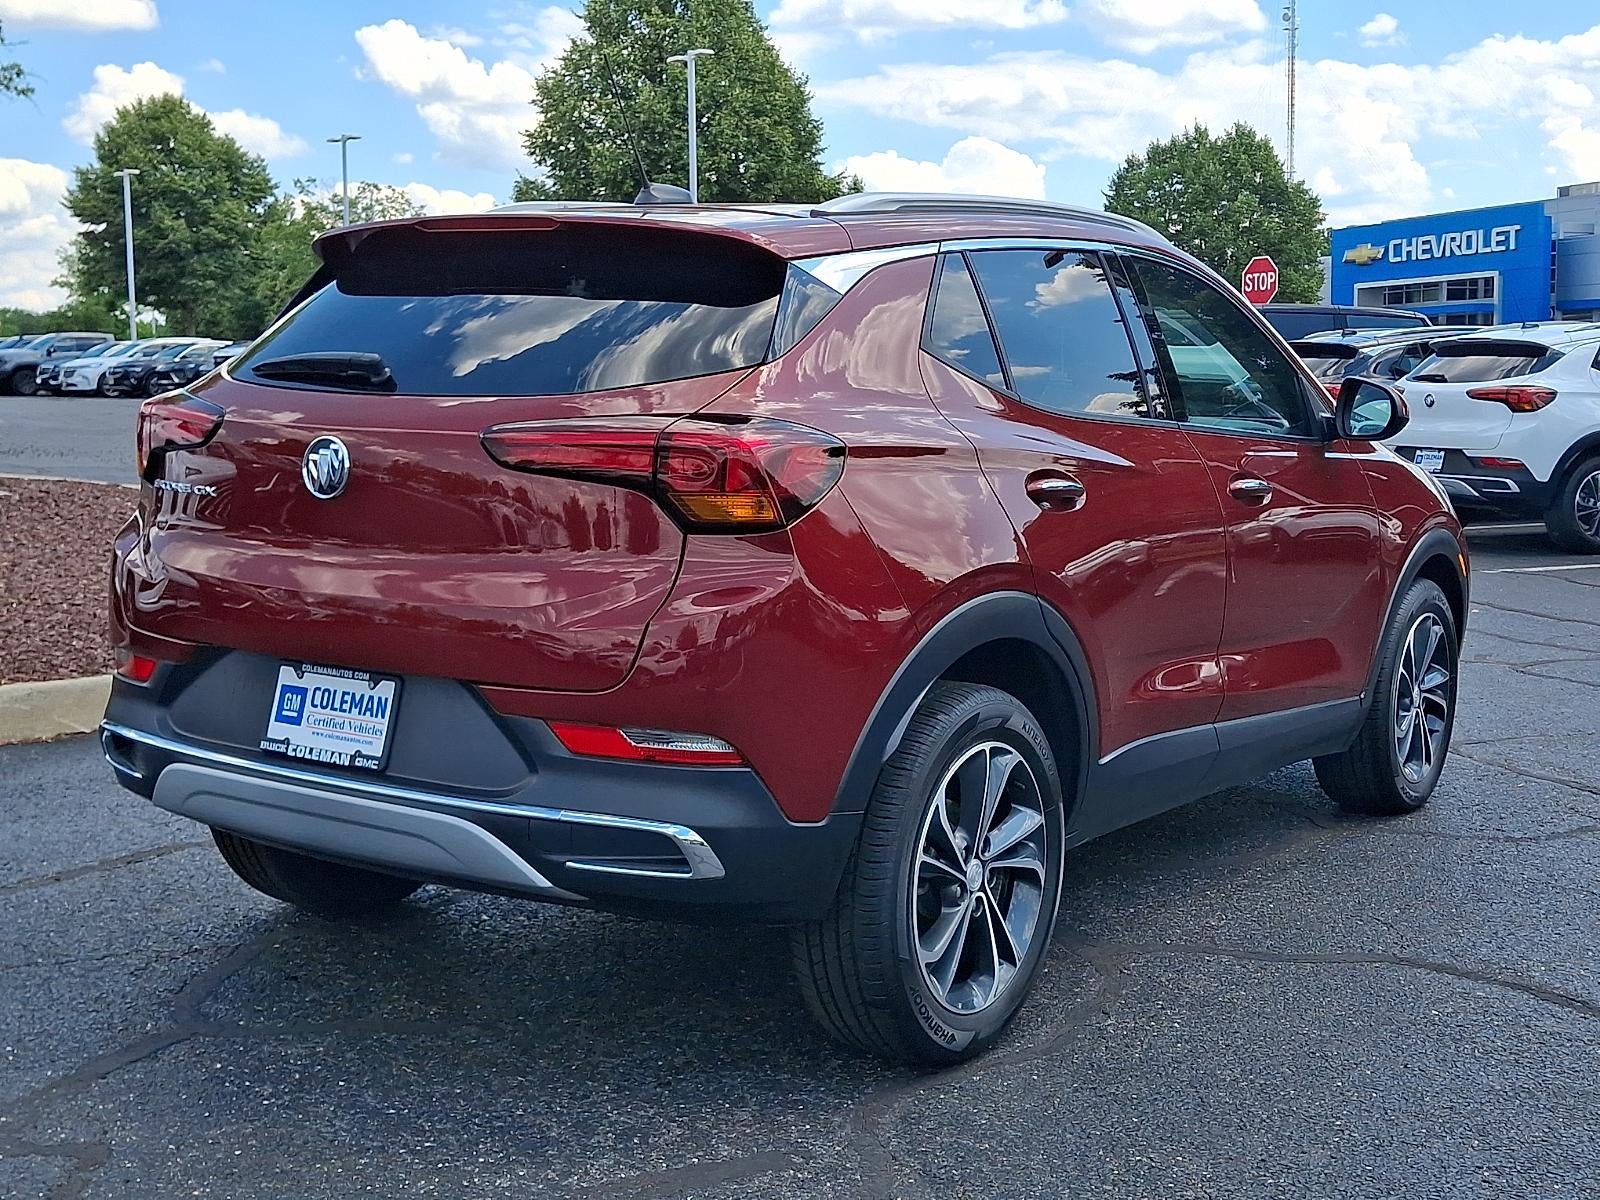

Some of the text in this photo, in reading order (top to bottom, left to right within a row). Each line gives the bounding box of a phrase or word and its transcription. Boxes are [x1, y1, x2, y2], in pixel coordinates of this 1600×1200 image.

[1388, 225, 1521, 263] CHEVROLET
[1245, 272, 1276, 292] STOP
[193, 485, 217, 497] GX
[283, 693, 301, 712] GM
[310, 686, 389, 719] COLEMAN
[306, 713, 384, 736] Certified Vehicles
[288, 745, 350, 766] COLEMAN
[354, 757, 379, 770] GMC
